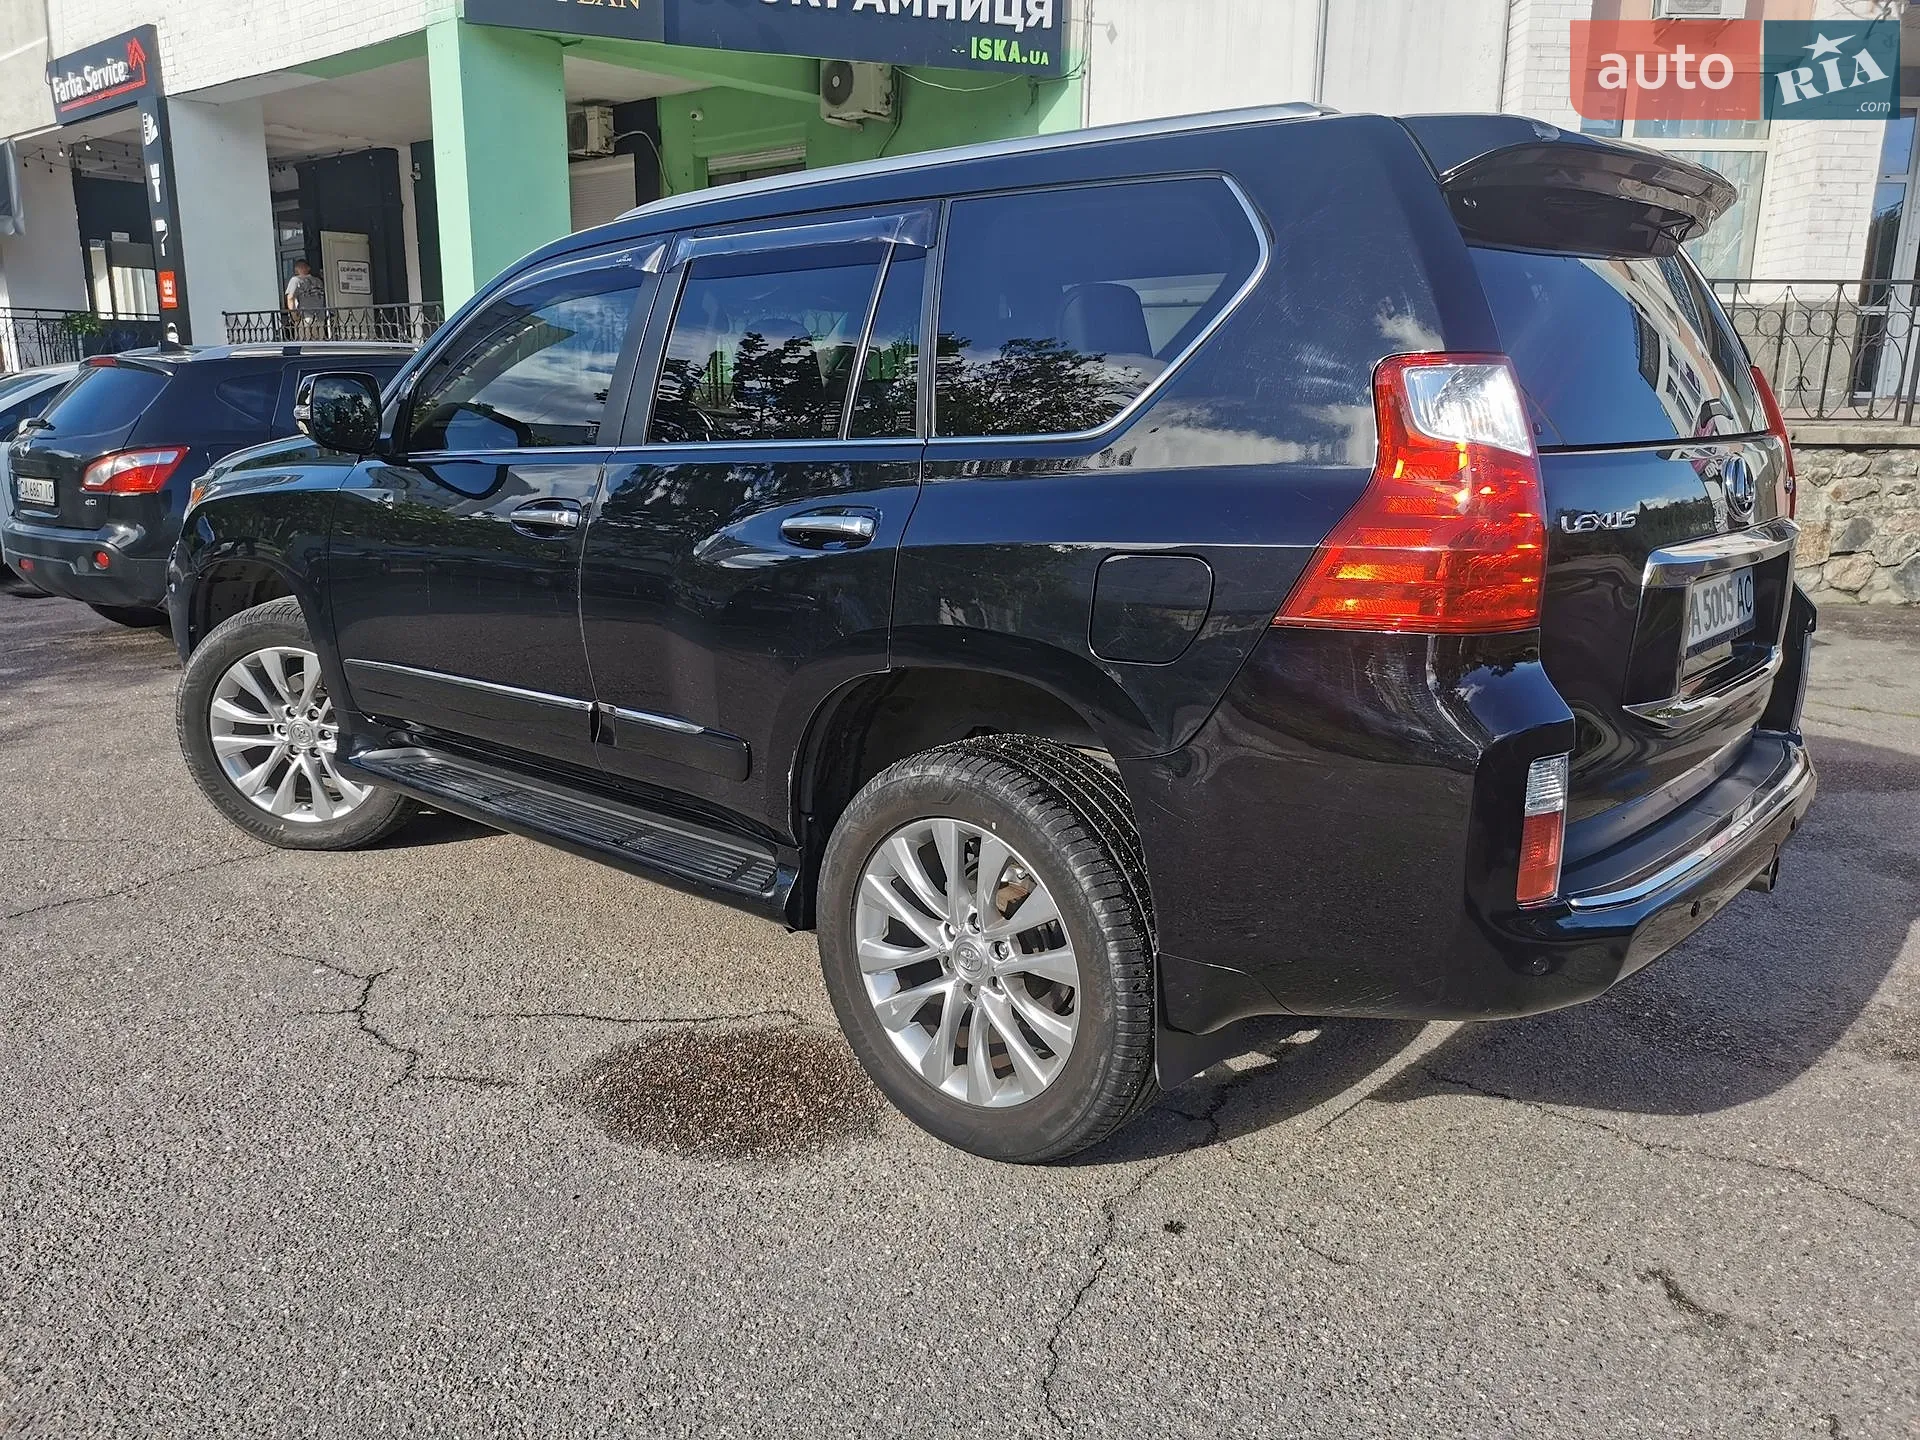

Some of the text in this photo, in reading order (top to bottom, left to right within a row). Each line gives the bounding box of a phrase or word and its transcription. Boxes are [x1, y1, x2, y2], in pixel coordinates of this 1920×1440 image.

[52, 57, 127, 104] Farba Service
[1561, 510, 1637, 533] LEXUS
[1702, 580, 1735, 632] 5005
[1737, 575, 1753, 619] AC
